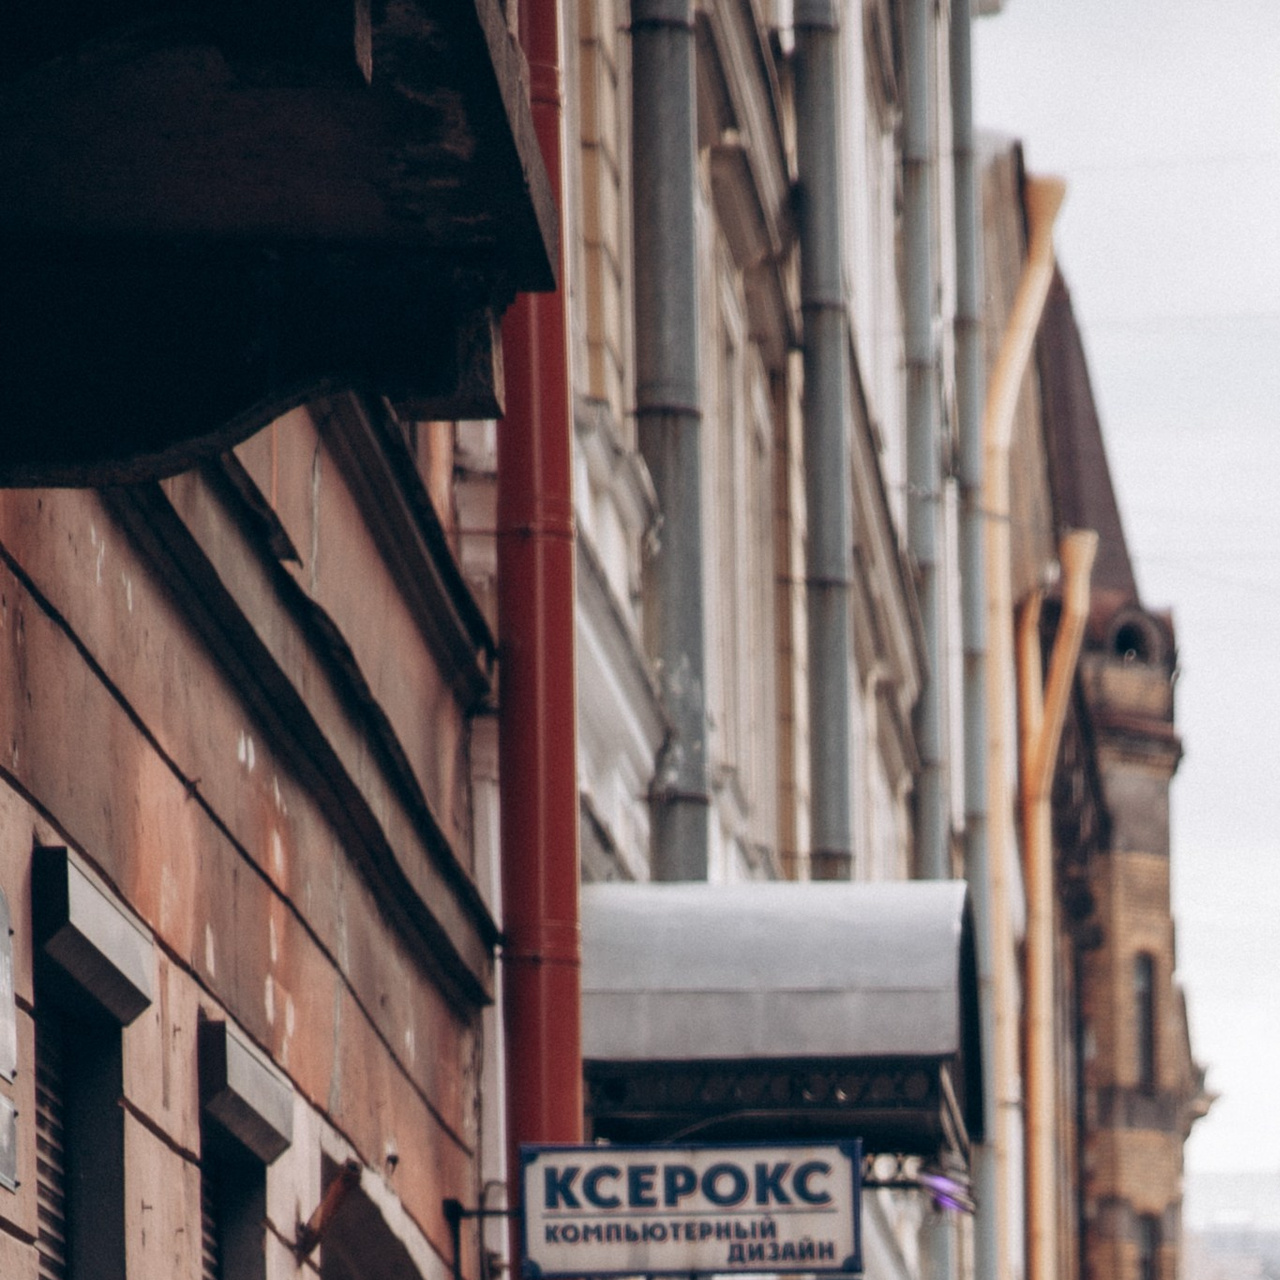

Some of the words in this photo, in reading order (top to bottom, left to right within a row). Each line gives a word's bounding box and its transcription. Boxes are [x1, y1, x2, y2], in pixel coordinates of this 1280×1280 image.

[543, 1160, 834, 1209] КСЕРОКС
[544, 1213, 778, 1244] КОМПЬЮТЕРНЫЙ
[726, 1237, 836, 1264] ДИЗАЙН
